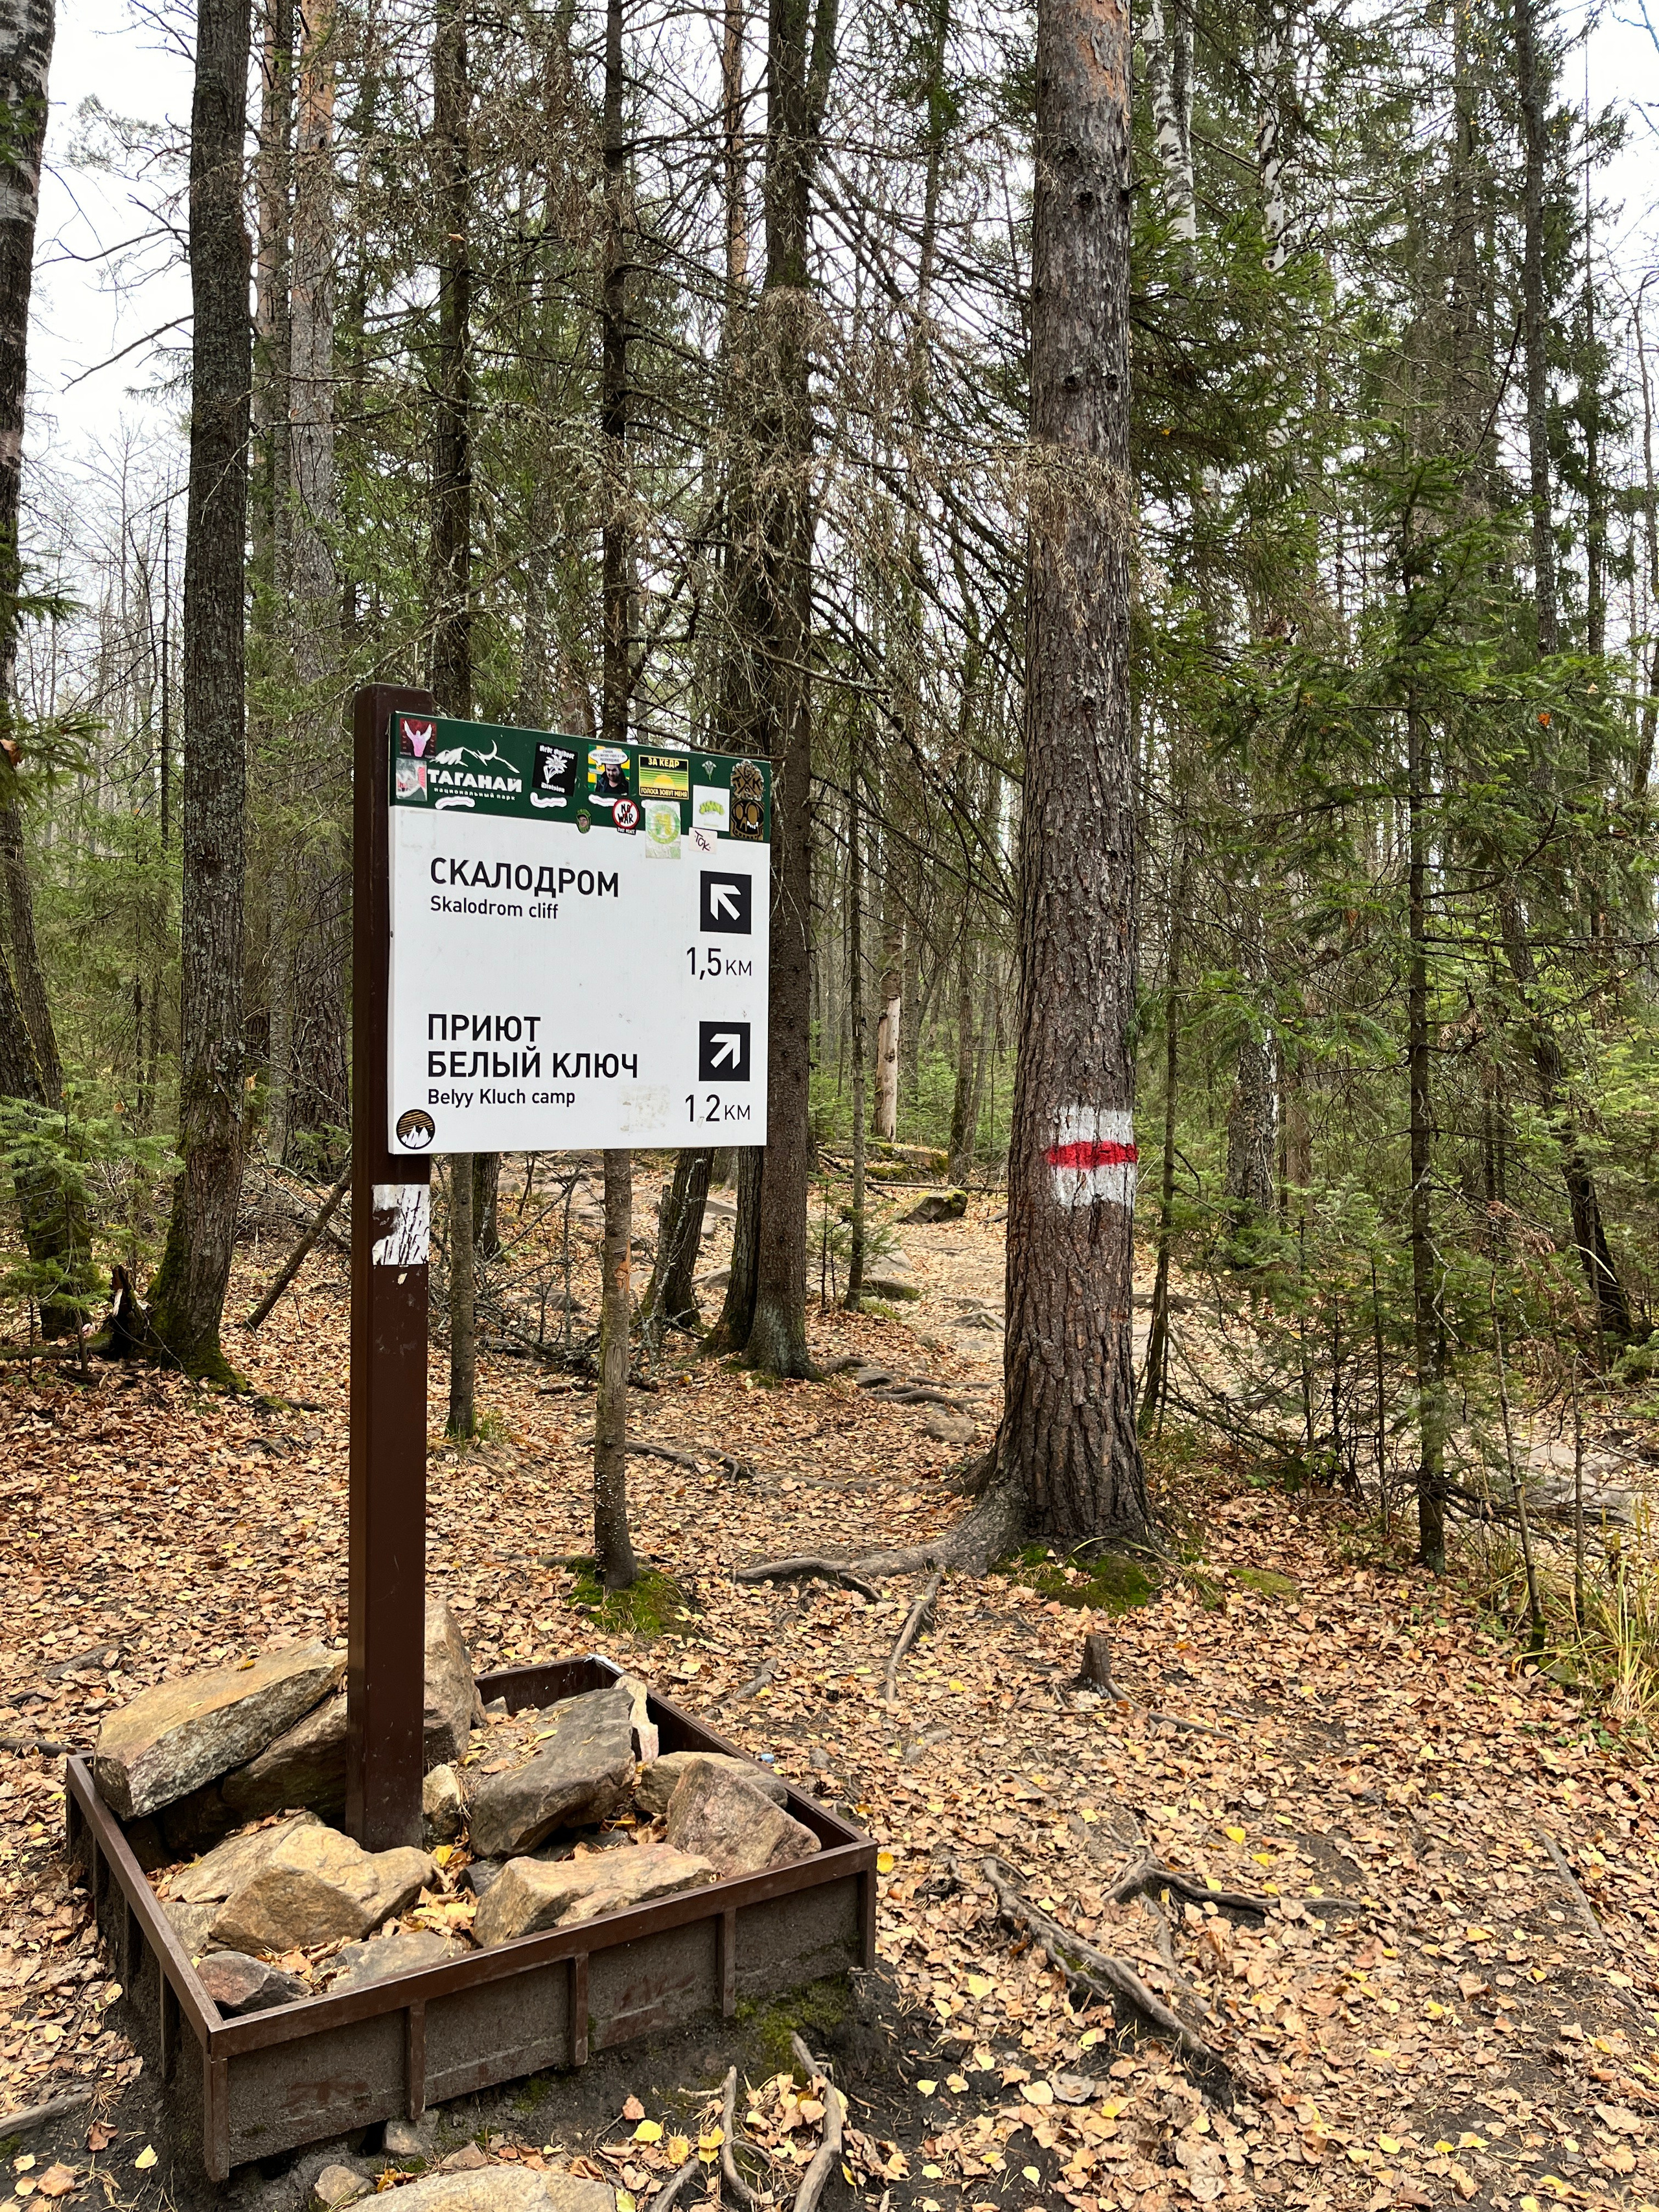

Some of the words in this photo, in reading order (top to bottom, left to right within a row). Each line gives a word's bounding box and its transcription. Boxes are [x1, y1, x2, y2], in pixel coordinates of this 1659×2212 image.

[648, 757, 658, 766] ЗА
[659, 758, 680, 769] КЕДР
[427, 769, 522, 793] ТАГАНАЙ
[434, 787, 494, 798] национальный
[618, 813, 634, 824] WAR
[621, 803, 631, 813] NO
[430, 857, 619, 898] СКАЛОДРОМ
[430, 895, 523, 917] Skalodrom
[529, 902, 559, 919] cliff
[686, 947, 722, 980] 1,5
[428, 1013, 541, 1042] ПРИЮТ
[428, 1045, 540, 1077] БЕЛЫЙ
[553, 1053, 638, 1078] КЛЮЧ
[428, 1088, 474, 1108] Belyy
[480, 1088, 526, 1104] Kluch
[531, 1091, 575, 1108] camp
